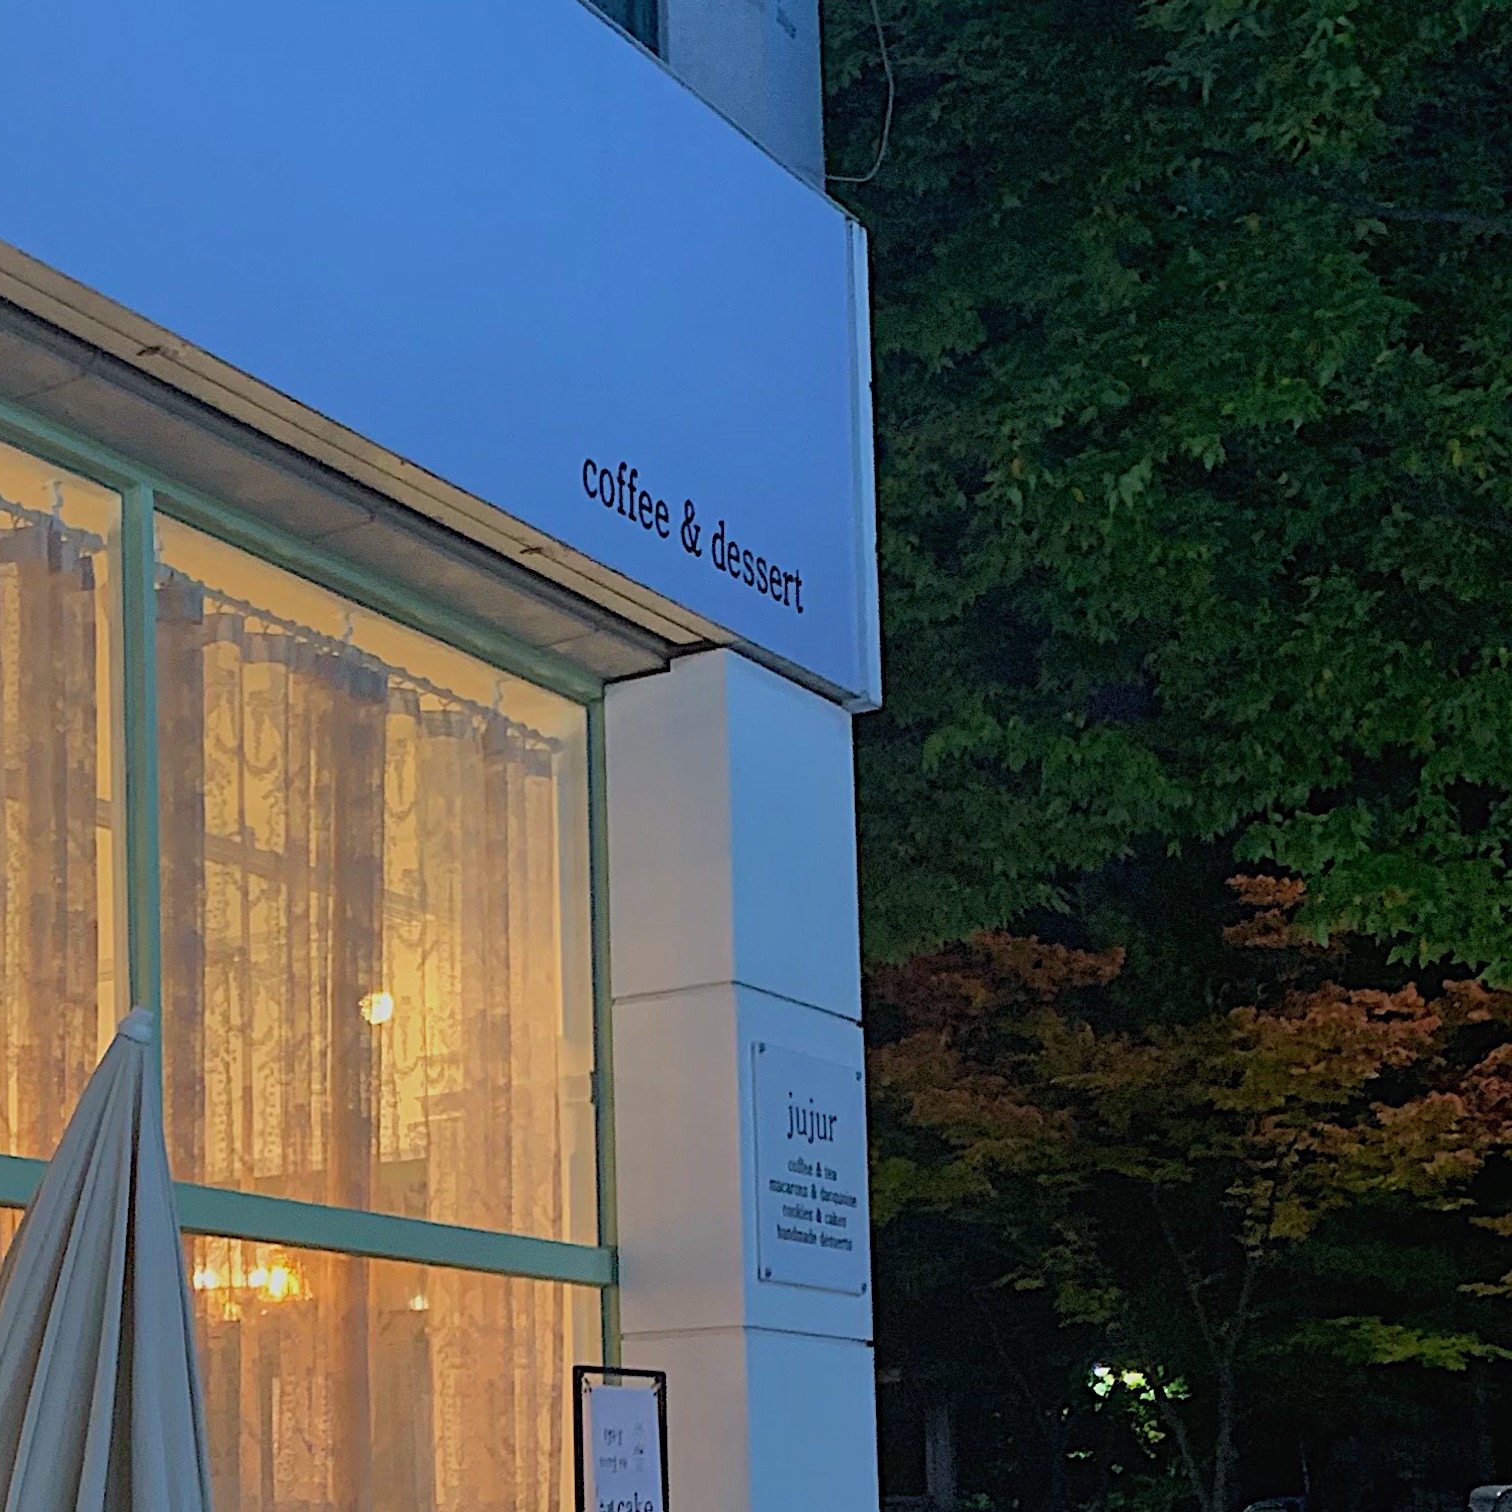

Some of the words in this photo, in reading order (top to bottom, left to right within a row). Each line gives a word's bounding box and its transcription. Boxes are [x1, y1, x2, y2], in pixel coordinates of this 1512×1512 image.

[582, 458, 670, 539] coffee
[680, 498, 702, 557] &
[711, 520, 804, 614] dessert
[787, 1091, 838, 1144] jujur
